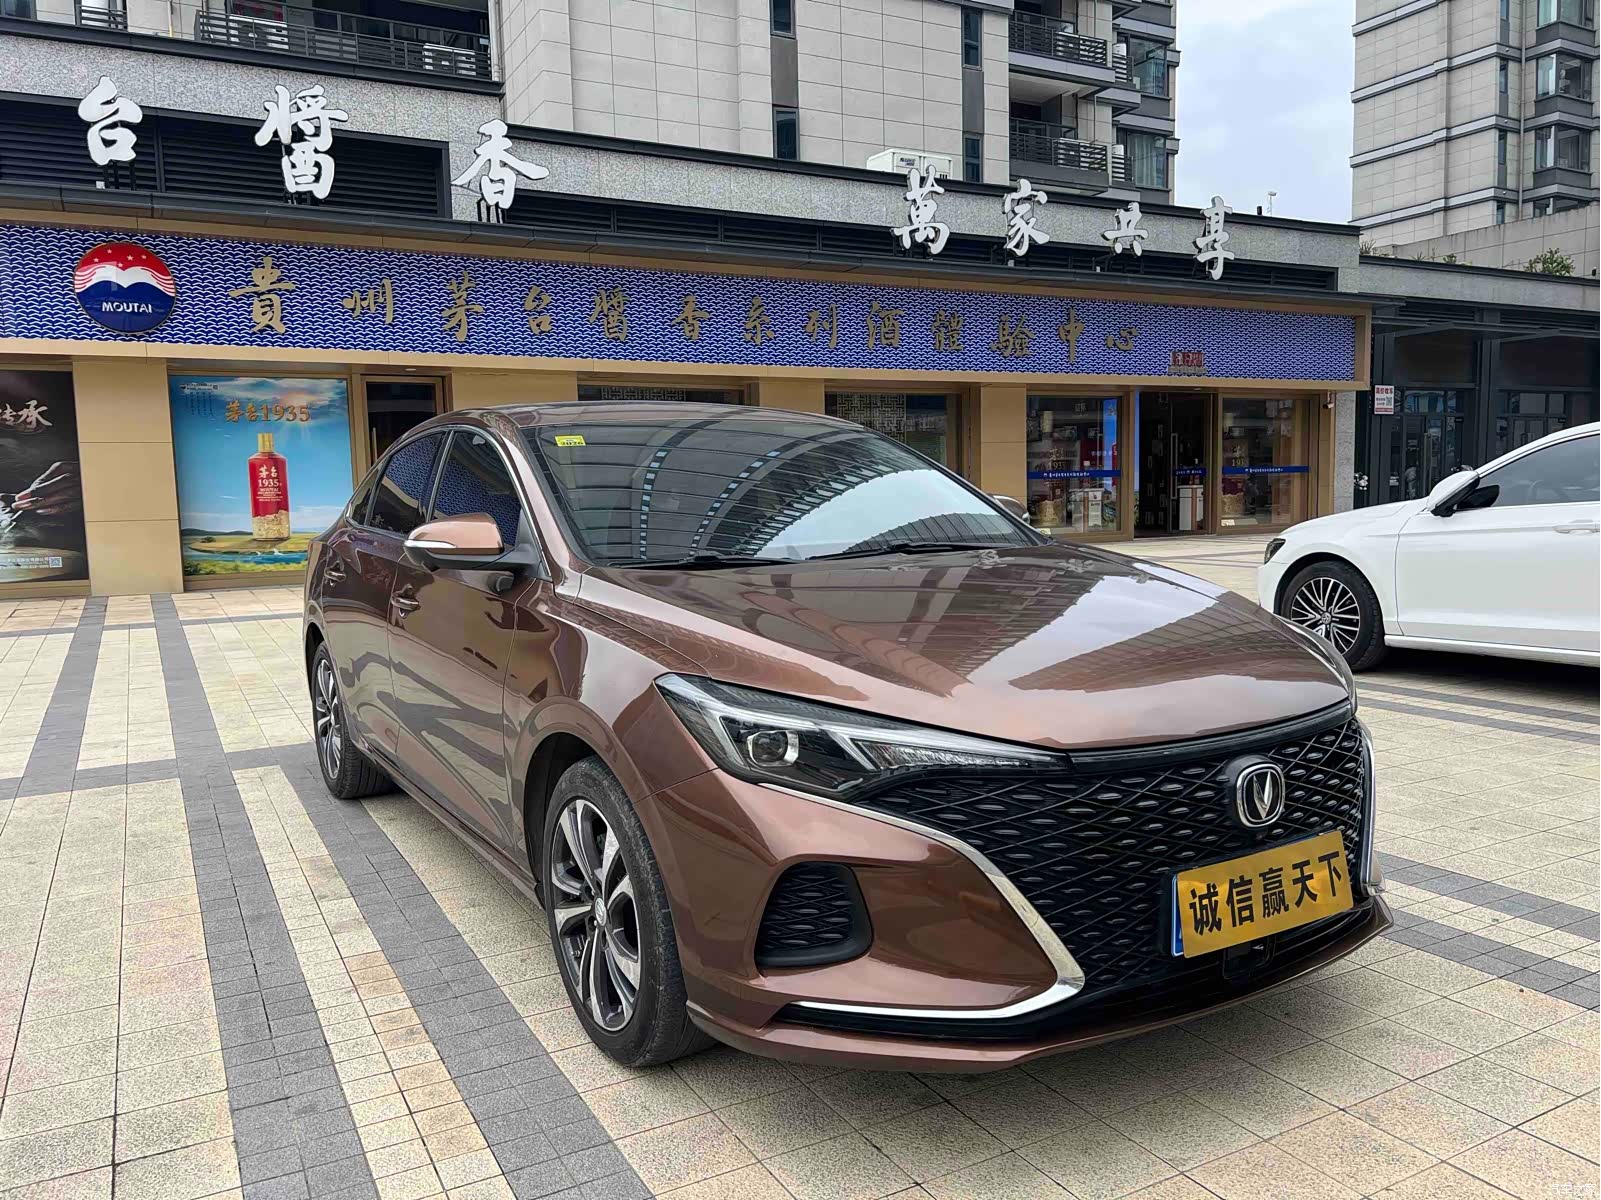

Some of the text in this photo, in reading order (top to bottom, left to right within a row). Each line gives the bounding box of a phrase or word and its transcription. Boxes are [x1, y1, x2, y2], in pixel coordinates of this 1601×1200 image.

[101, 301, 153, 314] MOUTAI
[258, 479, 280, 487] 1935
[1189, 850, 1342, 936] 诚信赢天下
